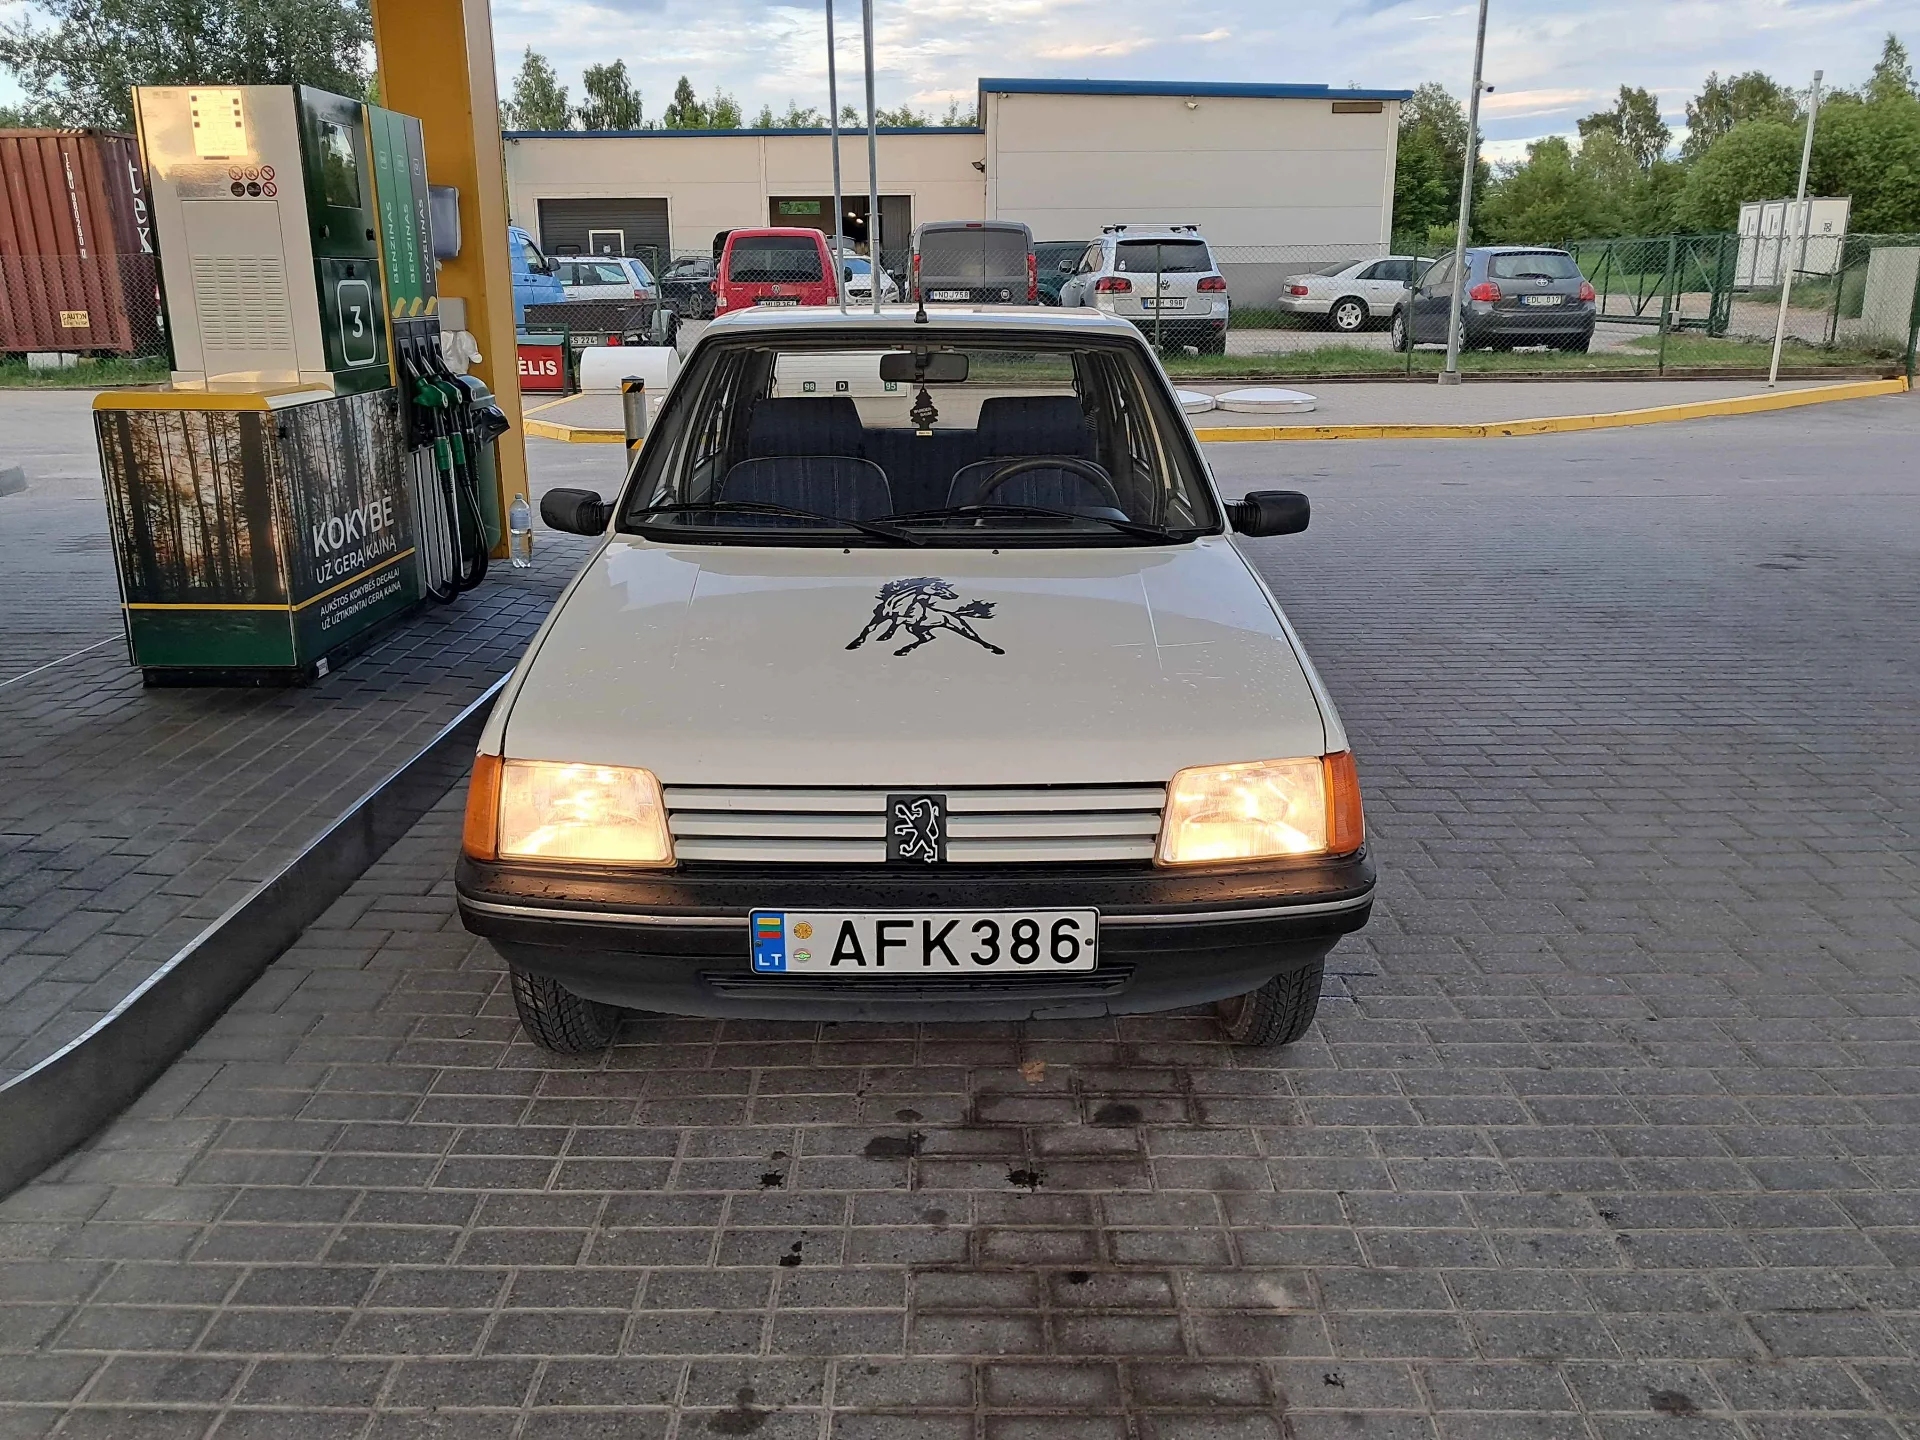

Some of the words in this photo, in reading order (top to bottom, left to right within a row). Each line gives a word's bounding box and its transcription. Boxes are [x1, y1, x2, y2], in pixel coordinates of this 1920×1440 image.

[128, 159, 153, 253] tex
[386, 202, 399, 284] BENZINAS
[403, 204, 416, 283] BENZINAS
[418, 199, 431, 284] DYZELINAS
[350, 306, 363, 338] 3
[580, 336, 595, 344] 224
[804, 382, 815, 391] 98
[839, 381, 846, 390] D
[885, 381, 897, 390] 95
[312, 489, 395, 558] KOKYBĖ
[316, 559, 333, 584] UŽ
[334, 549, 366, 575] GERĄ
[366, 534, 398, 560] KAINĄ
[320, 594, 349, 617] AUKŠTOS
[376, 567, 400, 587] DEGALAI
[321, 617, 332, 631] UŽ
[367, 591, 385, 606] GERĄ
[758, 953, 783, 966] LT
[829, 918, 1081, 967] AFK386
